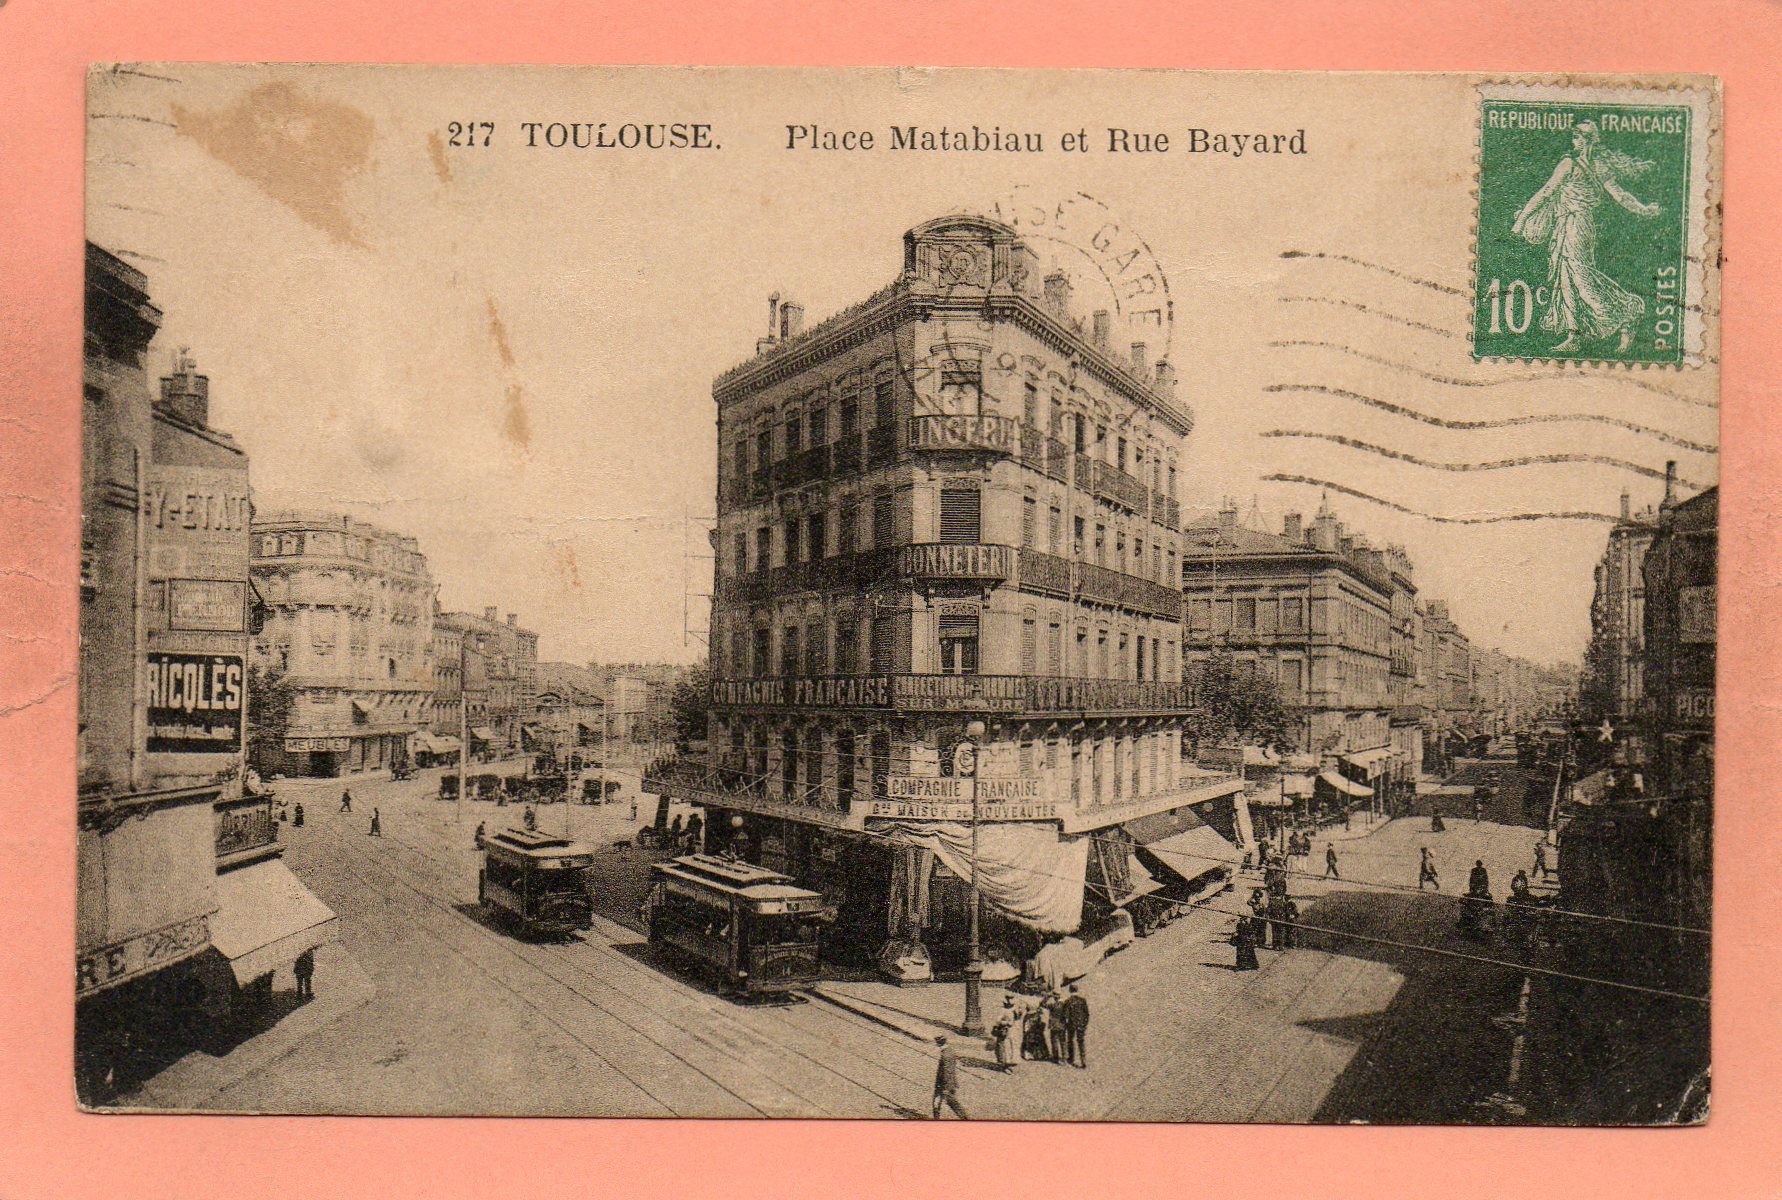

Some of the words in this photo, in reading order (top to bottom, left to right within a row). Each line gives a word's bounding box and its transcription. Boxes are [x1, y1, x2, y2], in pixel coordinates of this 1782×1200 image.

[1654, 265, 1678, 351] POSTES
[288, 738, 348, 751] MEUBLES
[891, 779, 961, 797] COMPAGNIE
[897, 804, 948, 818] MAISON
